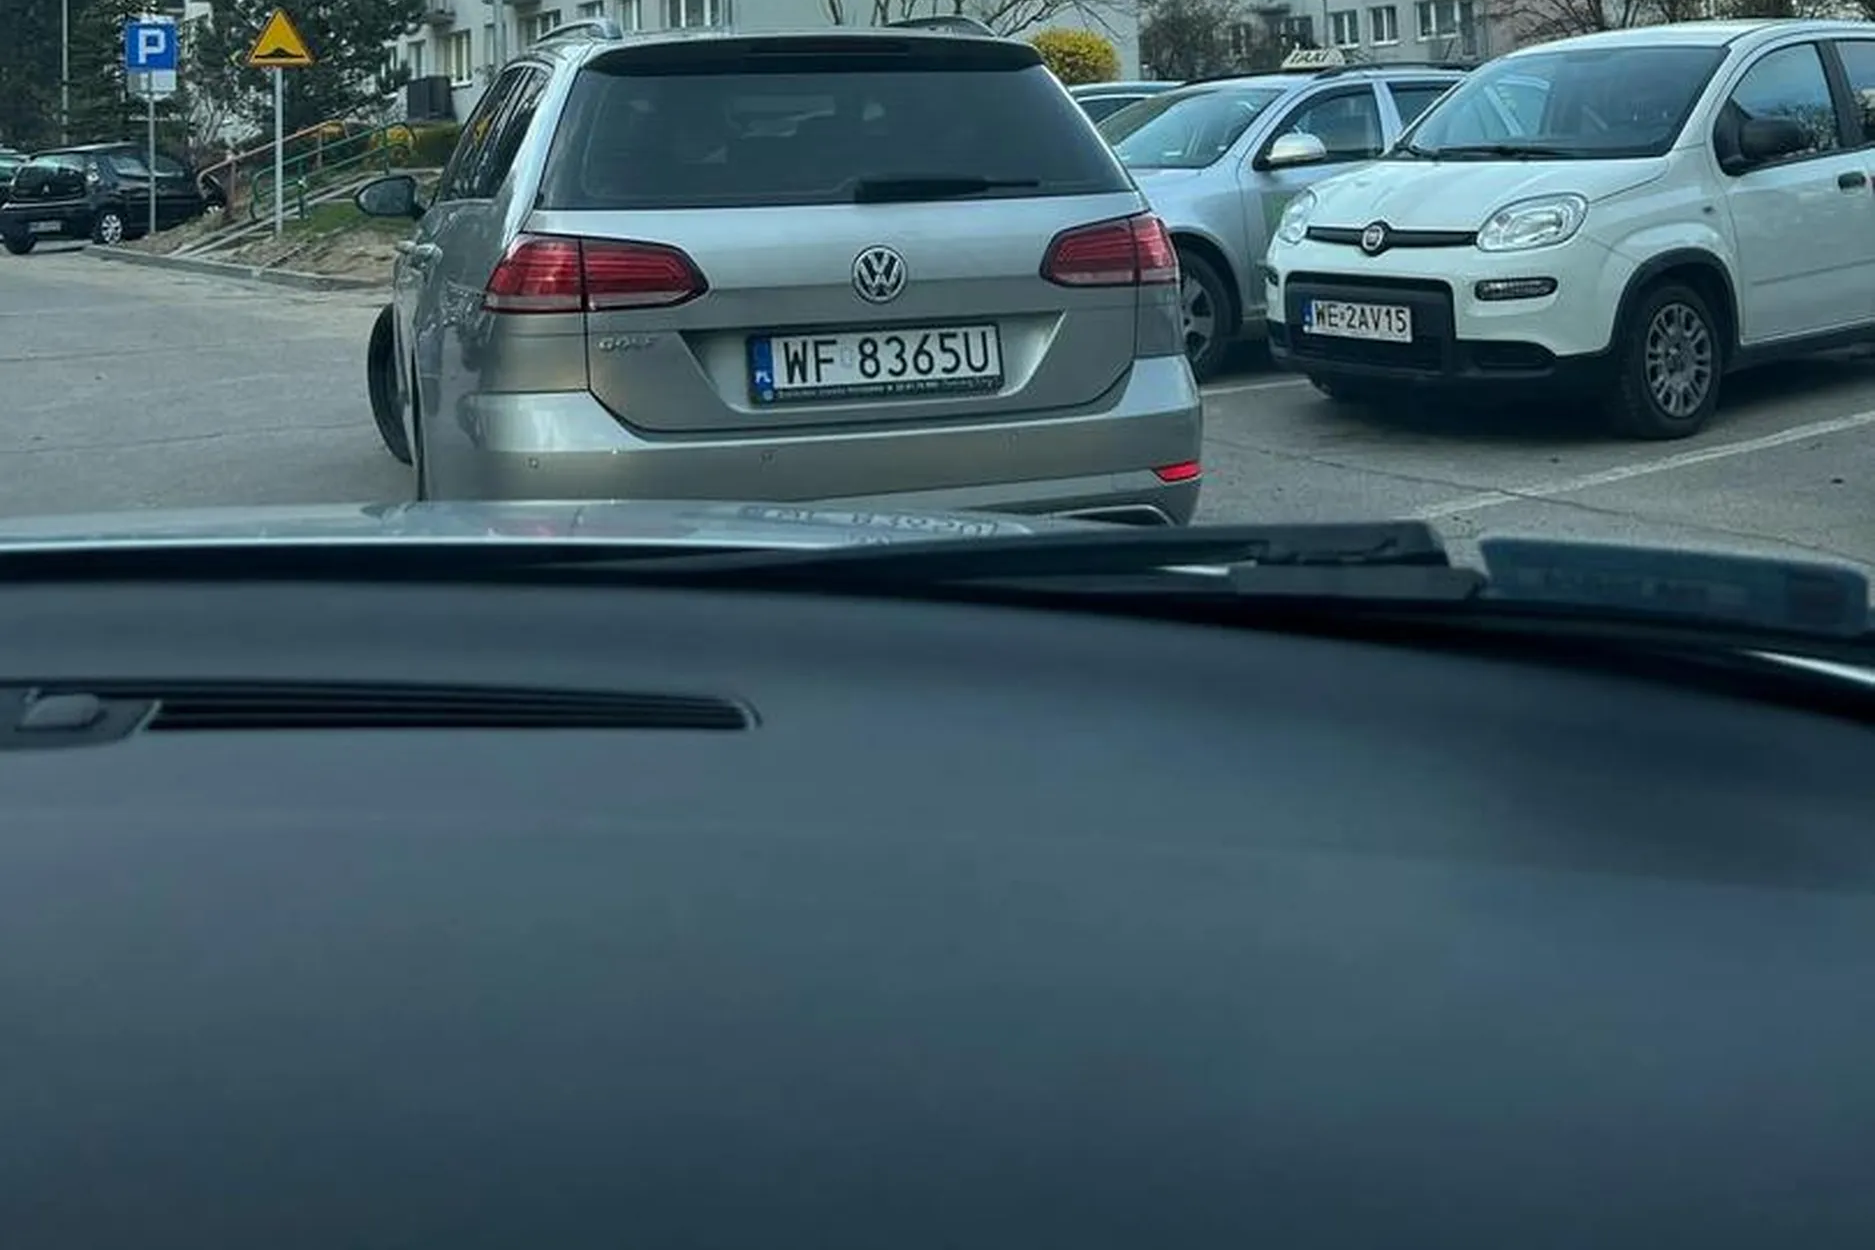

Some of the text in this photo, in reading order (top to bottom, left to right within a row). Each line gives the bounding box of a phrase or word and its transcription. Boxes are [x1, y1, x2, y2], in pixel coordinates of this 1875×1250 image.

[138, 28, 166, 64] P
[1290, 51, 1329, 64] TAXI
[1314, 302, 1340, 328] WE
[783, 331, 989, 384] WF 8365U
